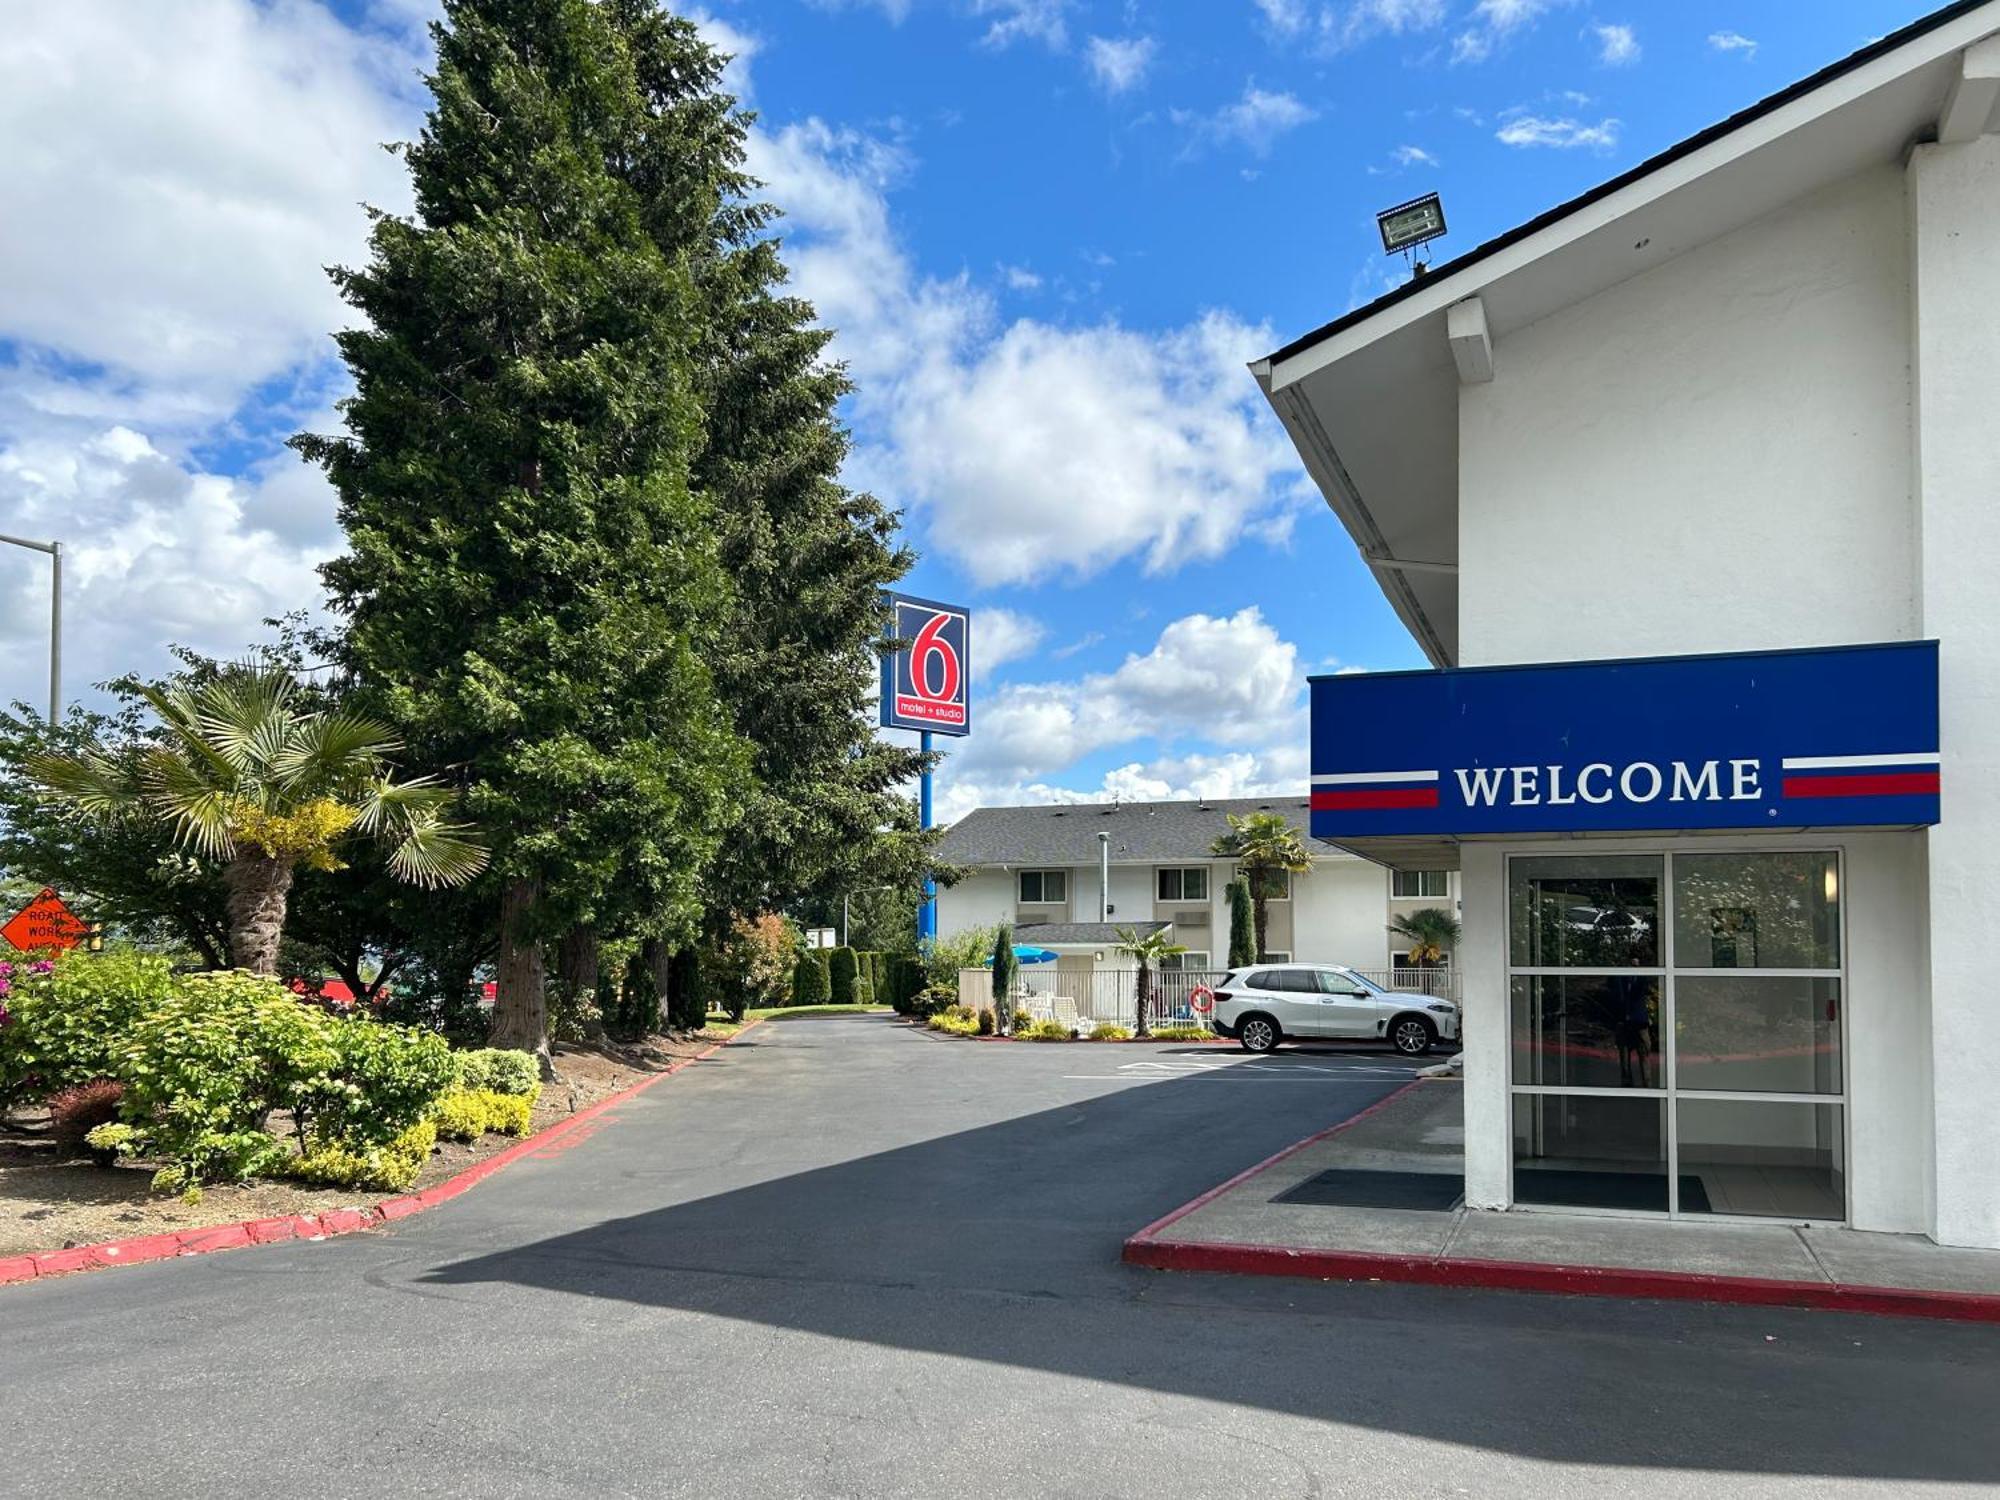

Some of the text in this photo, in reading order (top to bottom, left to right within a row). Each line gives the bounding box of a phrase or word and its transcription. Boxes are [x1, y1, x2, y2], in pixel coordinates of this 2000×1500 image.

[910, 612, 960, 704] 6
[901, 703, 926, 714] motel
[935, 708, 962, 719] studio
[1454, 759, 1762, 808] WELCOME
[30, 911, 62, 921] ROAD
[29, 927, 61, 937] WORK
